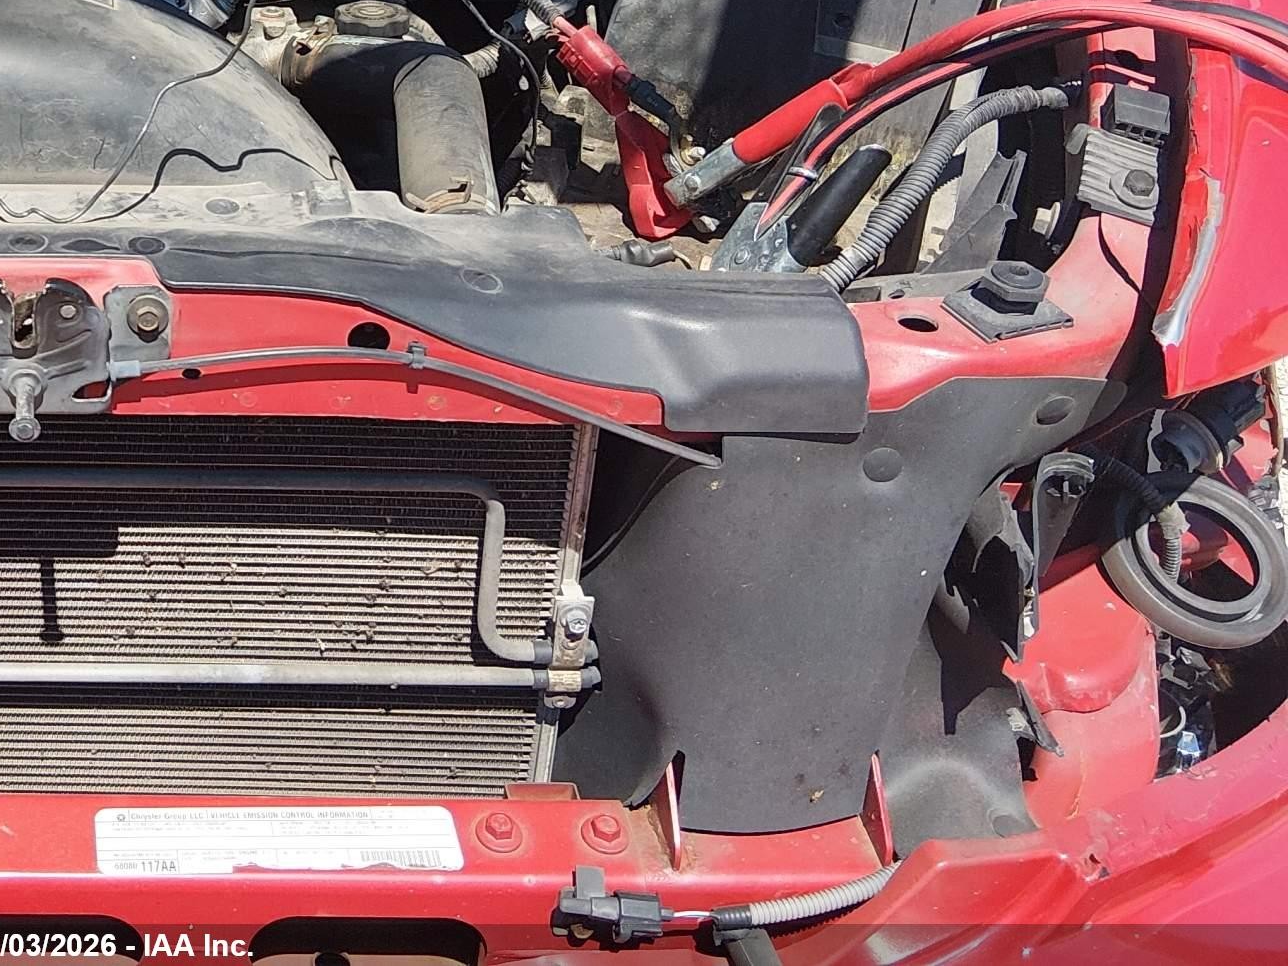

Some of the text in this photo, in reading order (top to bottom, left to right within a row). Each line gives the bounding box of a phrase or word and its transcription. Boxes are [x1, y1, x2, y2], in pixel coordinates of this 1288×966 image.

[130, 812, 161, 822] Chrysler
[163, 811, 187, 821] Group
[189, 811, 204, 820] LLC
[210, 810, 240, 820] VEHICLE
[243, 810, 279, 819] EMISSION
[280, 810, 315, 819] CONTROL
[317, 809, 369, 819] INFORMATION
[141, 860, 178, 873] 117AA
